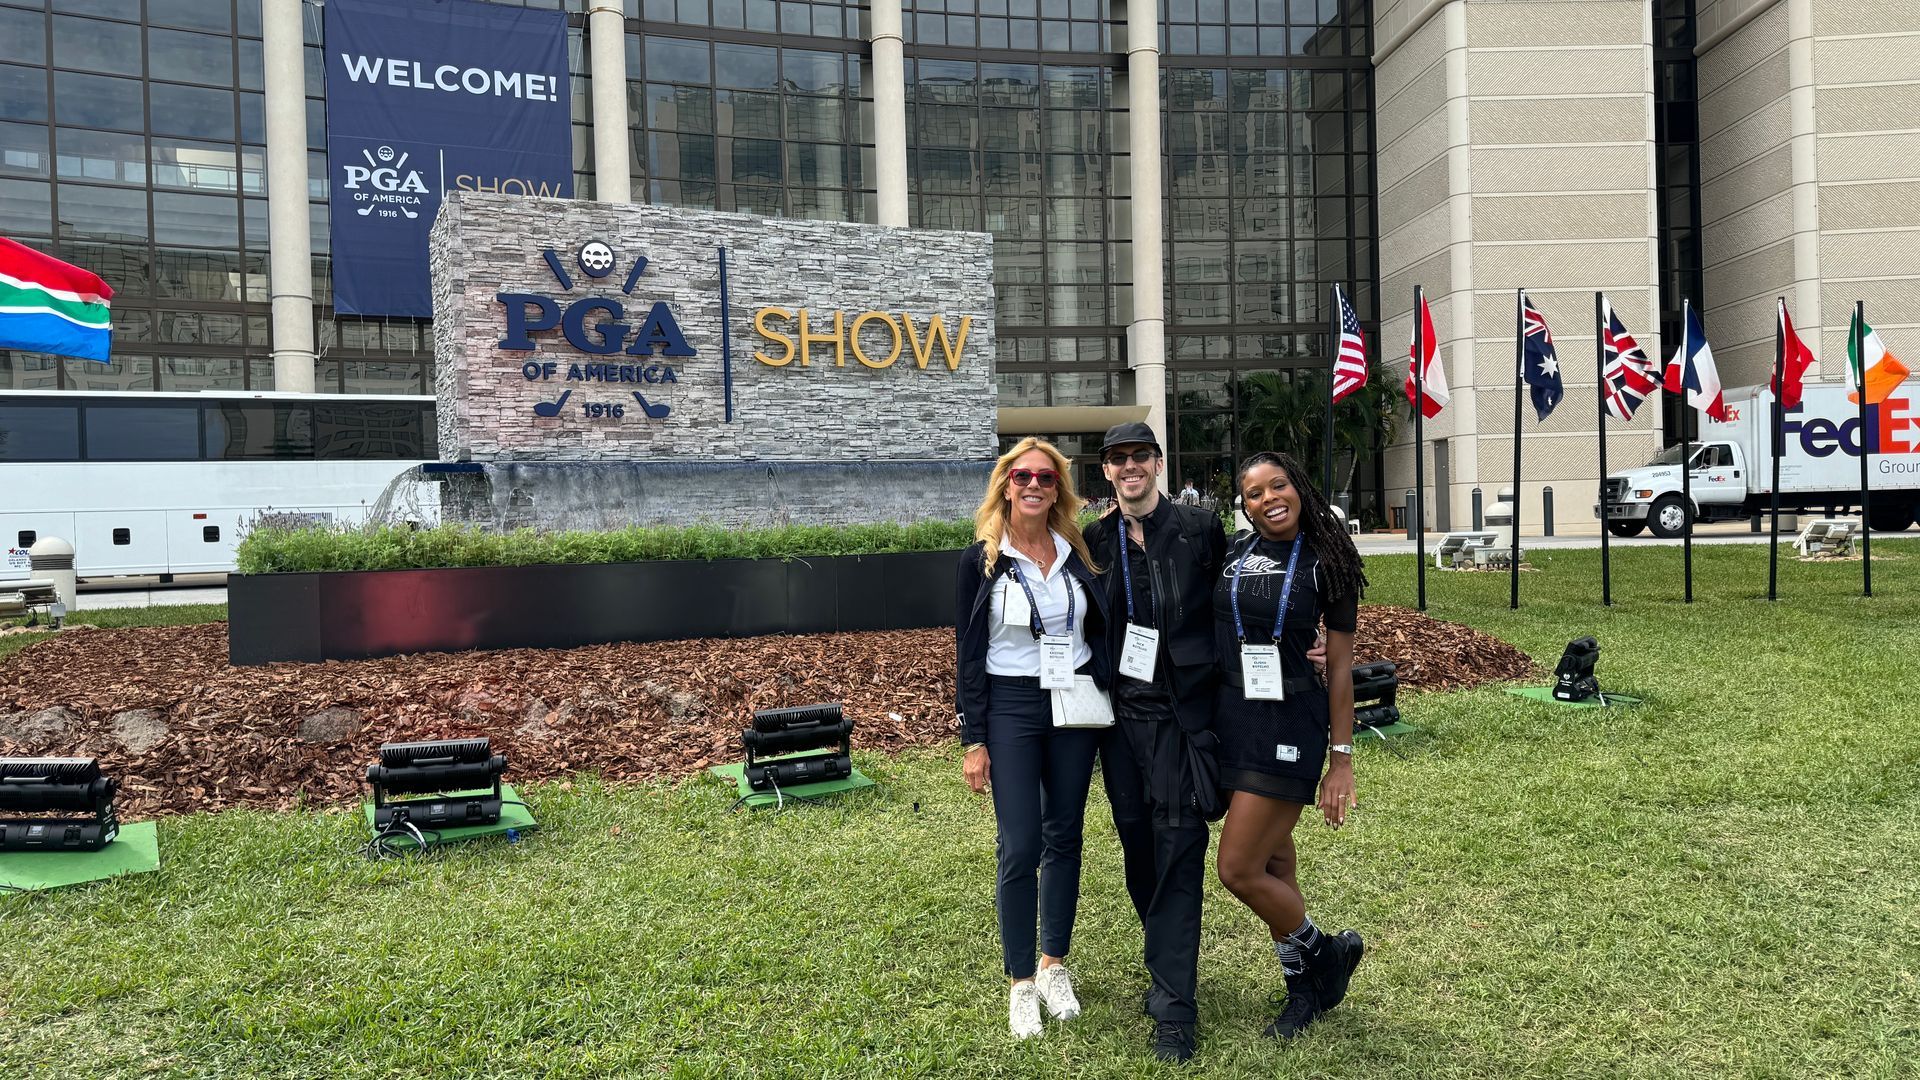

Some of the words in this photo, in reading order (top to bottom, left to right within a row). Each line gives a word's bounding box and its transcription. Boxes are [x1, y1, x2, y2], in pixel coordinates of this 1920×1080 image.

[341, 53, 558, 102] WELCOME!
[343, 165, 429, 194] PGA
[353, 192, 370, 202] OF
[372, 193, 421, 205] AMERICA
[378, 209, 398, 218] 1916
[496, 293, 697, 356] PGA
[754, 306, 973, 371] SHOW
[522, 362, 557, 381] OF
[566, 363, 678, 384] AMERICA
[582, 402, 625, 419] 1916
[1770, 398, 1920, 458] FedE
